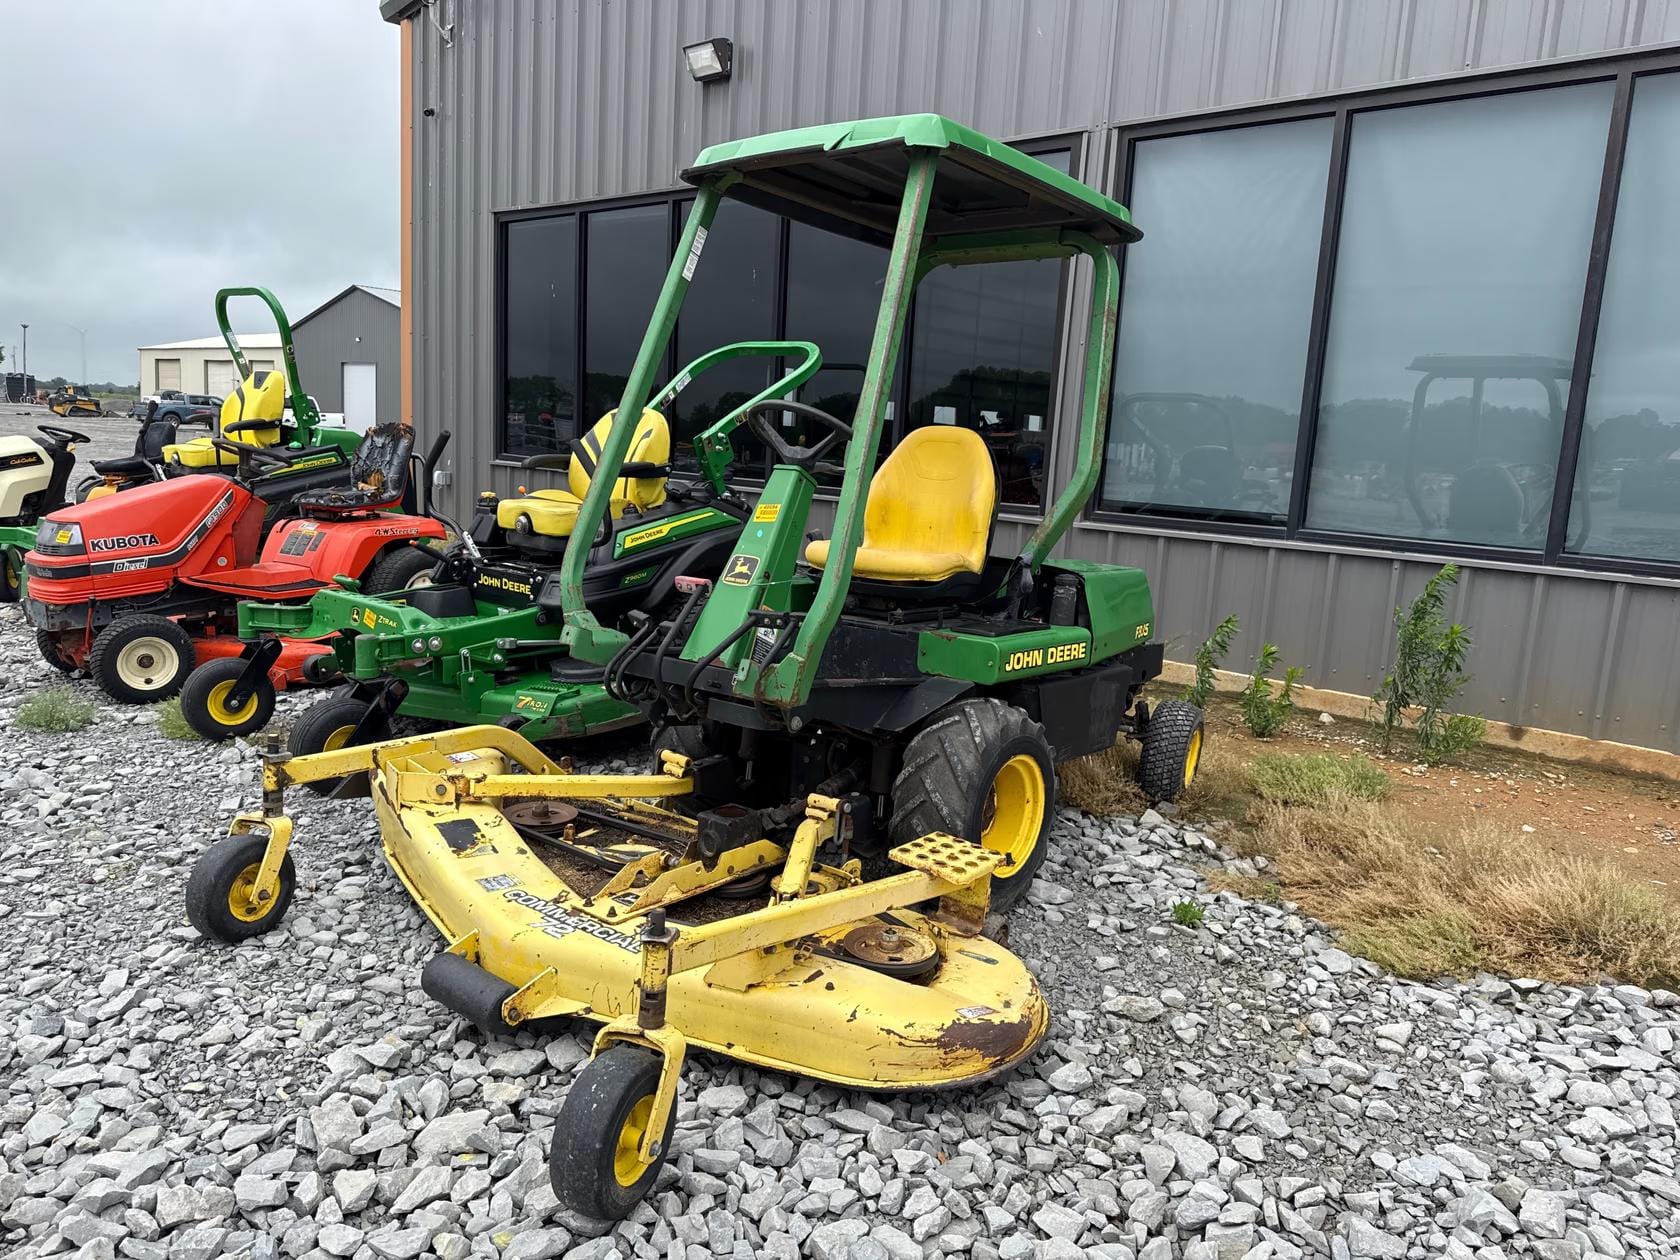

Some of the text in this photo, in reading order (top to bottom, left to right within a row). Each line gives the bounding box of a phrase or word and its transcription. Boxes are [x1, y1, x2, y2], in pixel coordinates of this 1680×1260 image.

[90, 534, 160, 552] KUBOTA
[630, 529, 664, 544] JOHN DEERE
[478, 573, 532, 595] JOHN DEERE
[1005, 642, 1087, 672] JOHN DEERE
[503, 889, 642, 954] COMMERCIAL
[527, 915, 577, 940] 72
